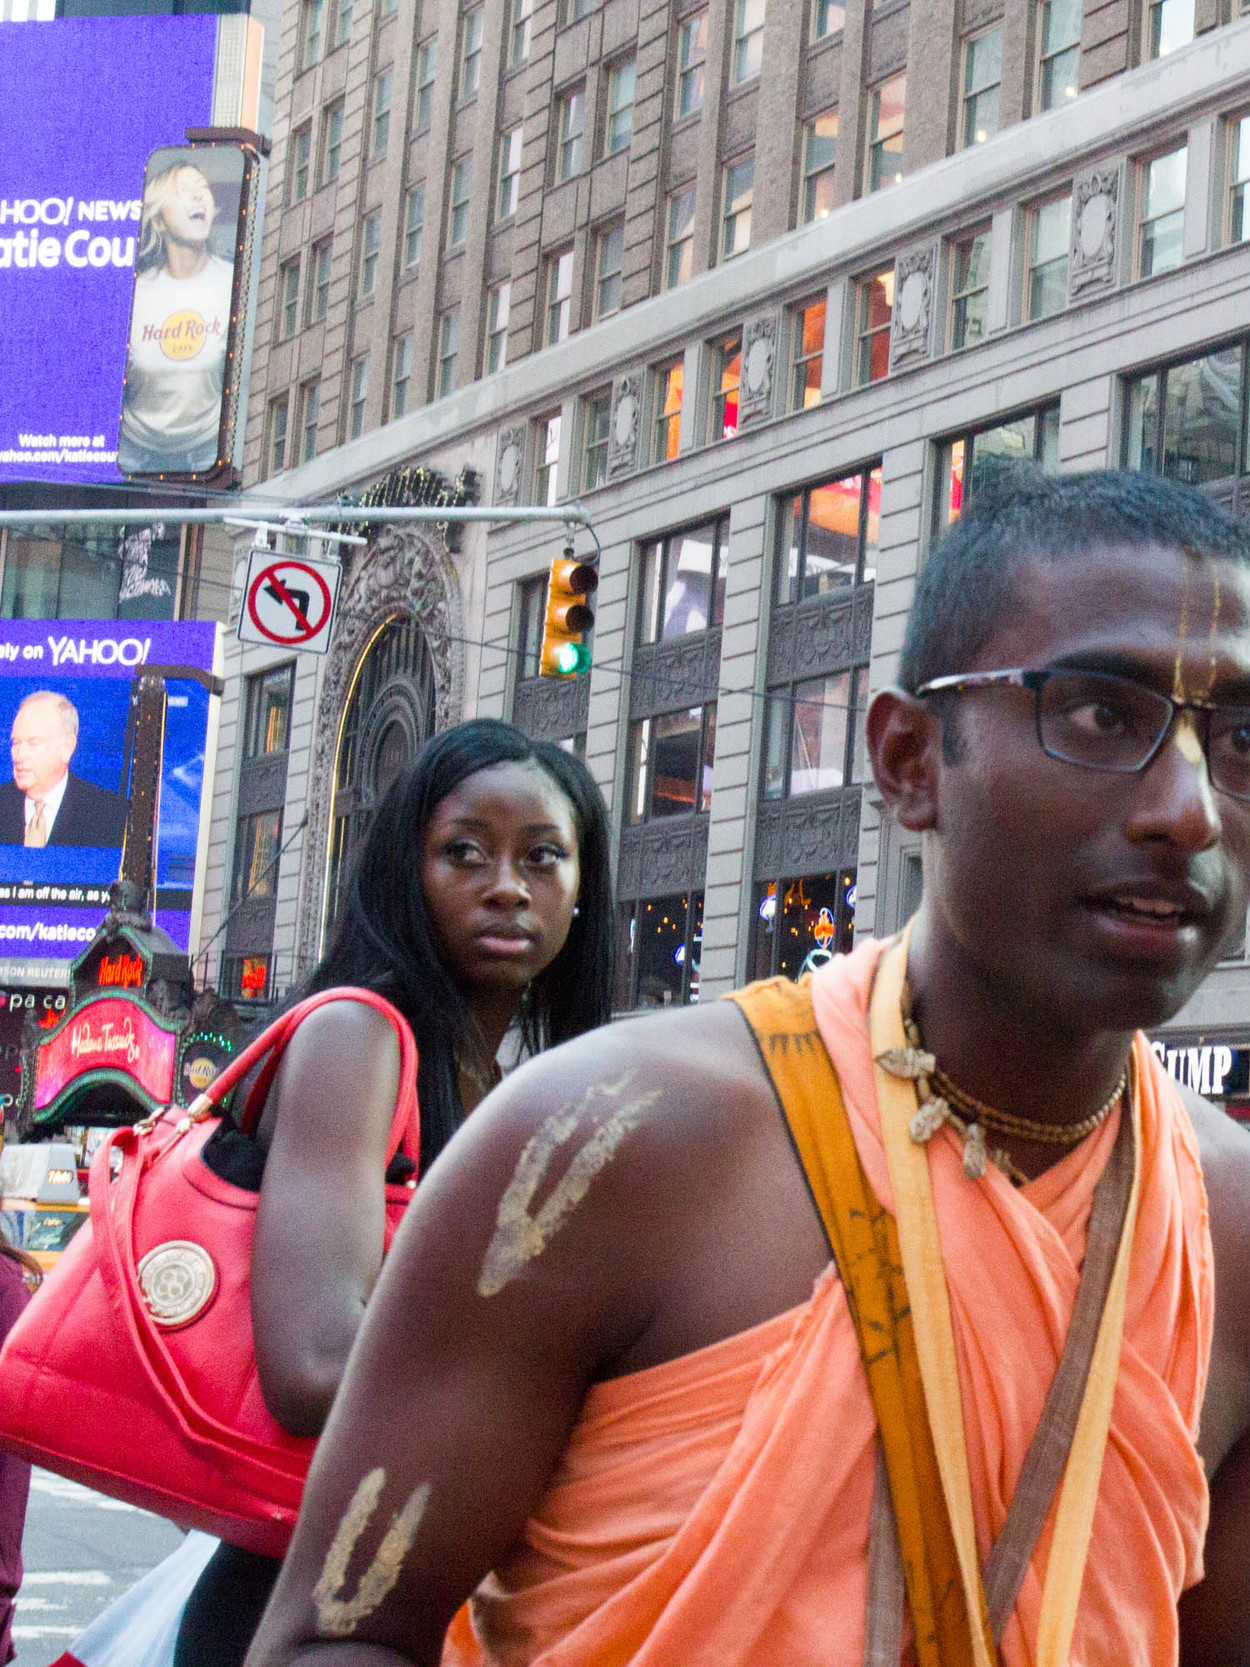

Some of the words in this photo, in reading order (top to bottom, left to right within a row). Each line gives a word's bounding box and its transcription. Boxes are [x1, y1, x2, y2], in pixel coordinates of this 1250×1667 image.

[78, 200, 141, 221] NEWS
[65, 229, 135, 268] Cou
[142, 321, 183, 342] Hard
[186, 318, 220, 340] Rock
[19, 434, 57, 447] Watch
[59, 436, 91, 447] more
[92, 435, 105, 447] at
[22, 644, 44, 660] on
[48, 635, 153, 667] YAHOO!
[36, 886, 50, 900] off
[51, 887, 67, 900] the
